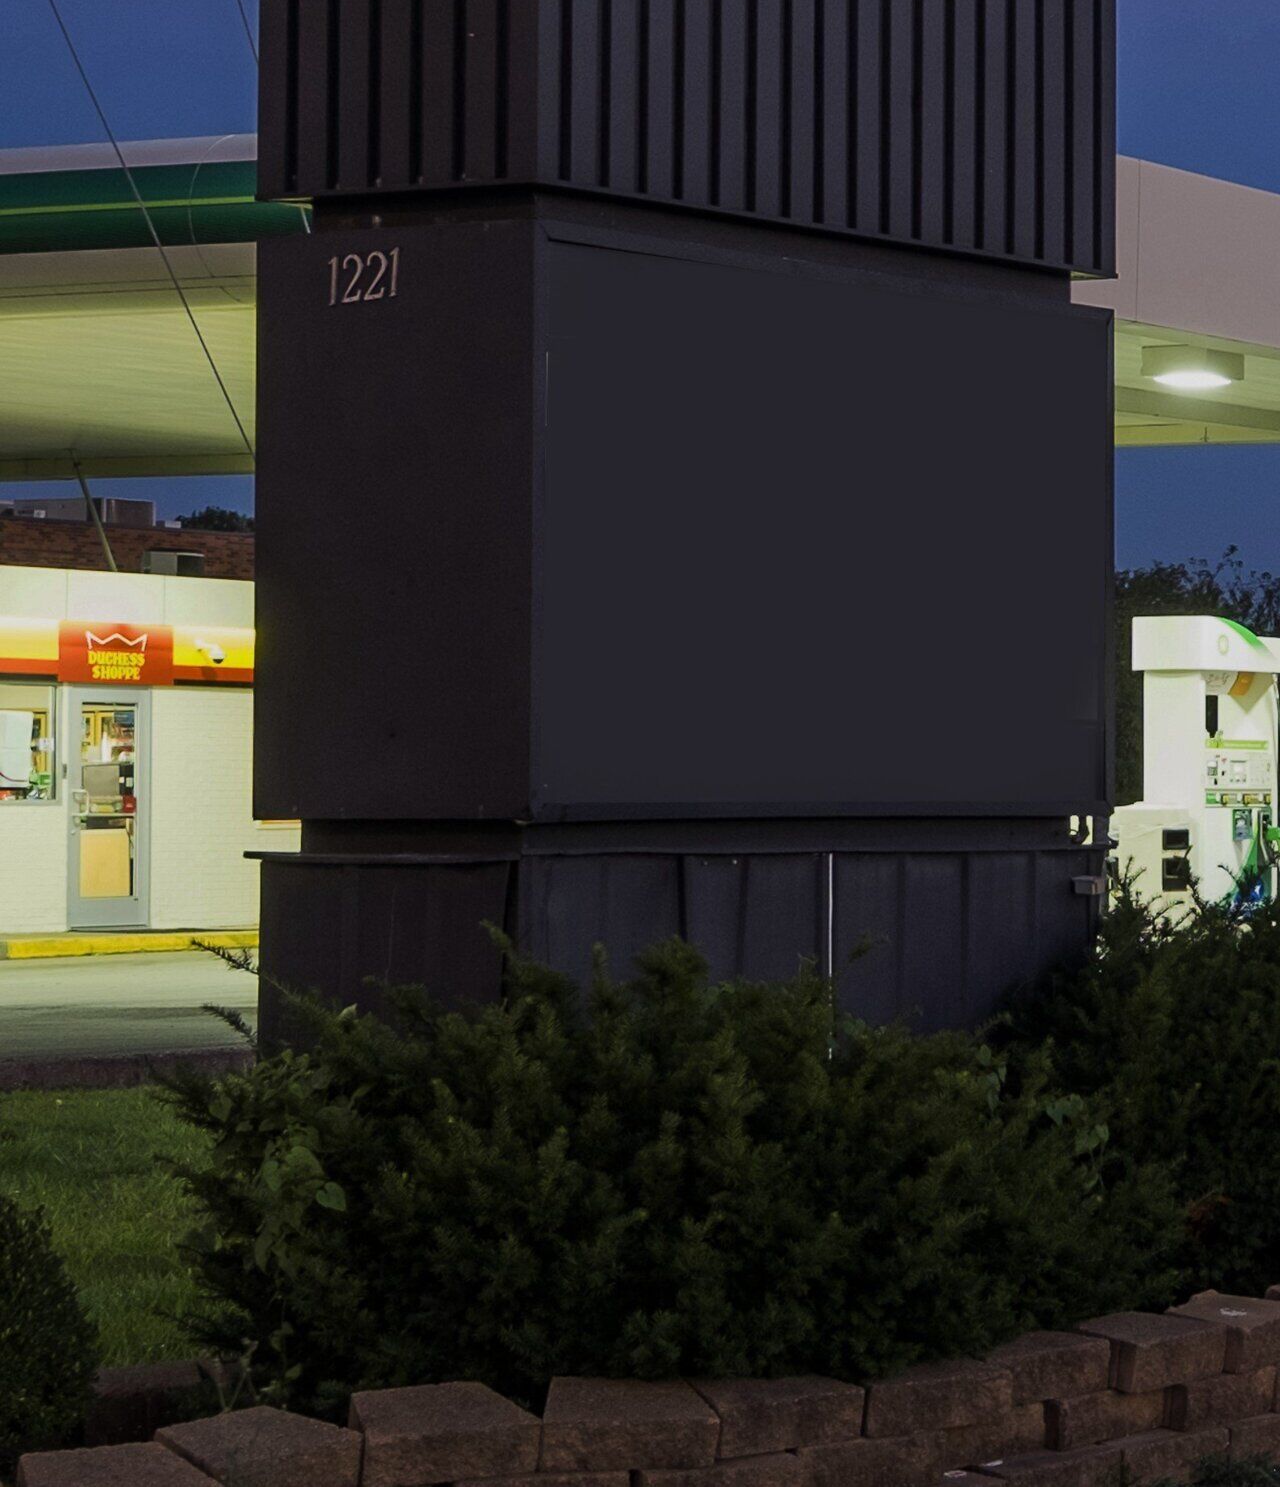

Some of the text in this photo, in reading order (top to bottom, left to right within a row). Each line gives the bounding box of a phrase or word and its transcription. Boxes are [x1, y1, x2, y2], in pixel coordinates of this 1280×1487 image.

[328, 247, 400, 306] 1221
[88, 651, 145, 667] DUCHESS
[91, 665, 140, 680] SHOPPE
